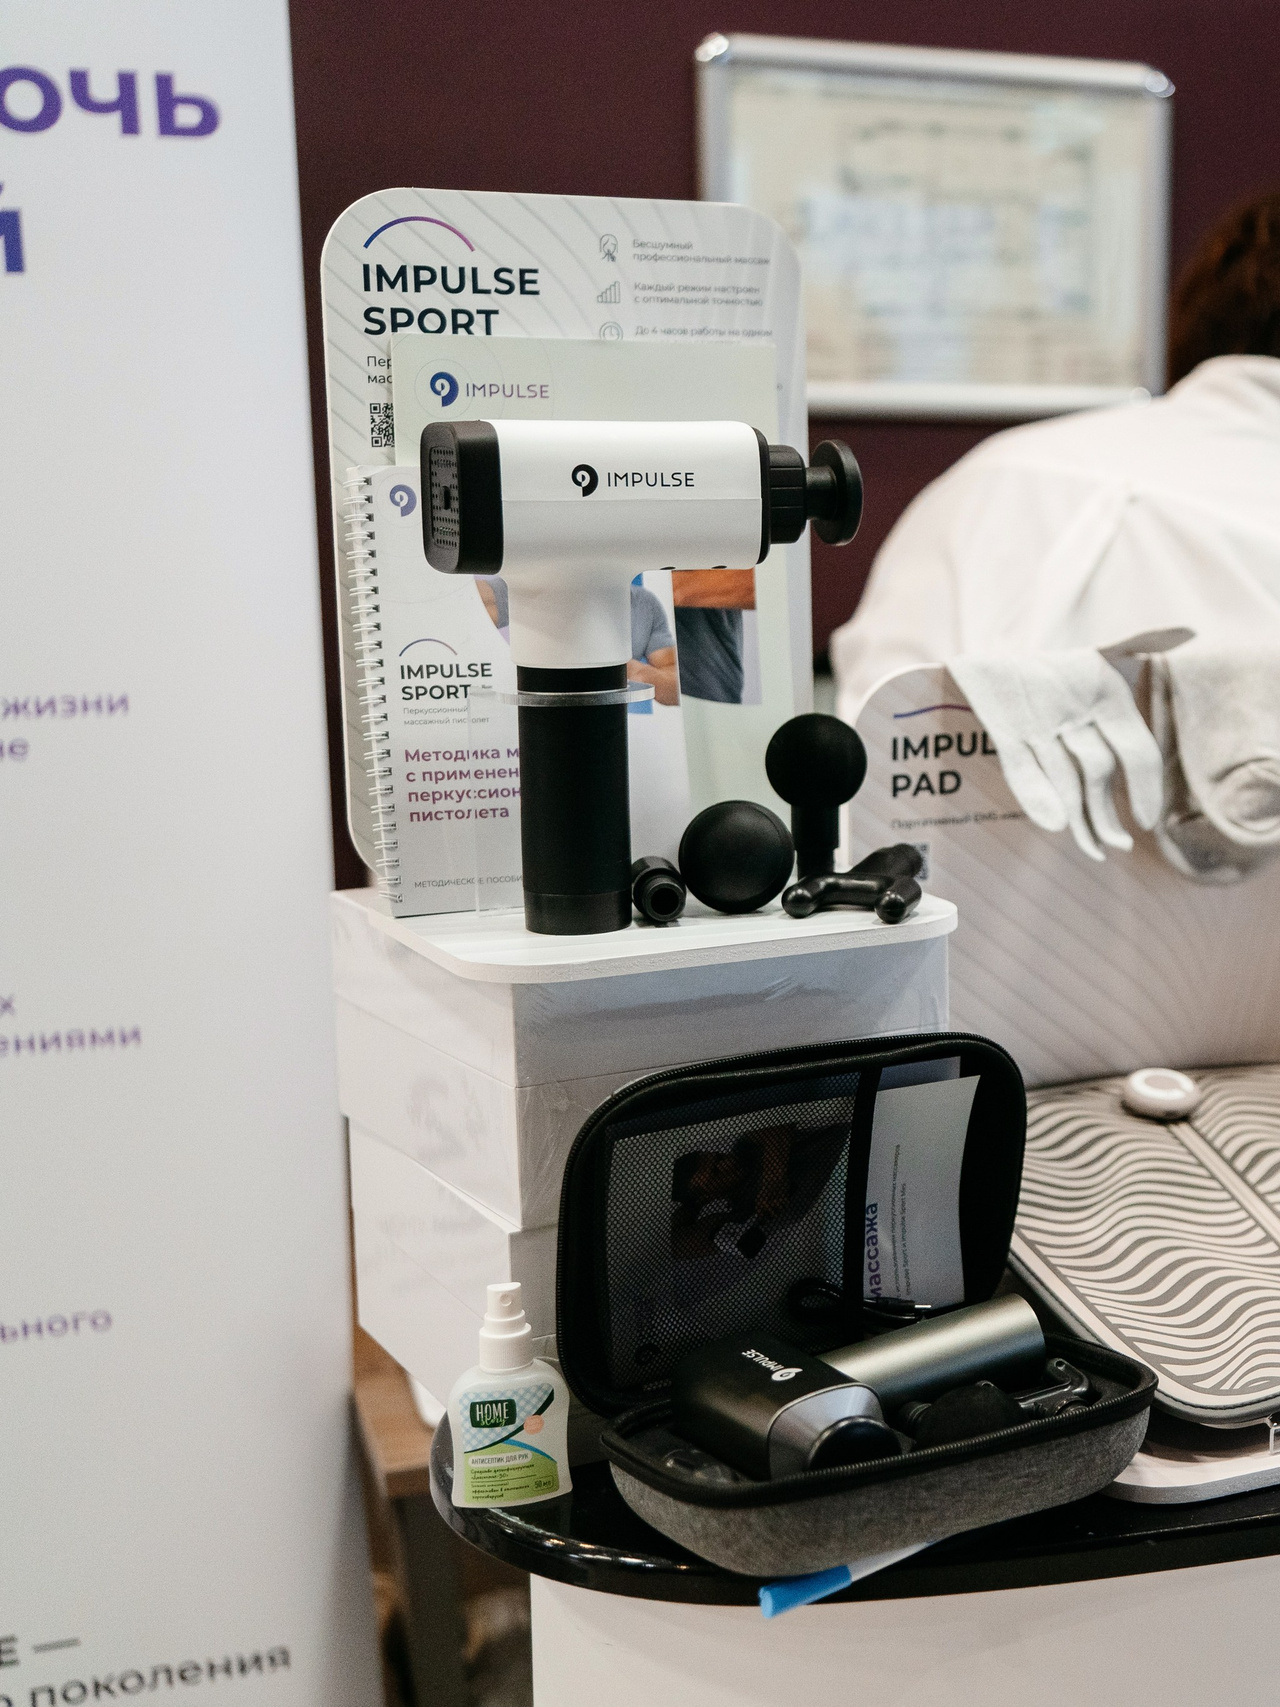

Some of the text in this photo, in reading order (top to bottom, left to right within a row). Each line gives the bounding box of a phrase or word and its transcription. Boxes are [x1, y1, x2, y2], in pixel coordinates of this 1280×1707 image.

[632, 239, 694, 250] Бесшумный
[632, 253, 732, 264] профессиональный
[363, 263, 540, 296] IMPULSE
[634, 281, 760, 295] Каждый режим настроен
[642, 296, 710, 305] оптимальной
[363, 306, 499, 336] SPORT
[635, 326, 649, 336] До
[690, 326, 726, 337] работы
[466, 382, 550, 399] IMPULSE
[607, 471, 695, 487] IMPULSE
[400, 662, 492, 680] IMPULSE
[401, 684, 472, 701] SPORT
[403, 705, 469, 716] Перкуссионный
[403, 717, 451, 726] массажный
[404, 747, 501, 763] Методика
[406, 771, 416, 783] с
[891, 769, 962, 798] PAD
[409, 806, 510, 823] пистолета
[741, 1348, 785, 1372] IMPULSE
[476, 1401, 510, 1422] HOME
[471, 1456, 505, 1465] АНТИСЕПТИК
[505, 1455, 518, 1463] ДЛЯ
[29, 1644, 292, 1707] поколения
